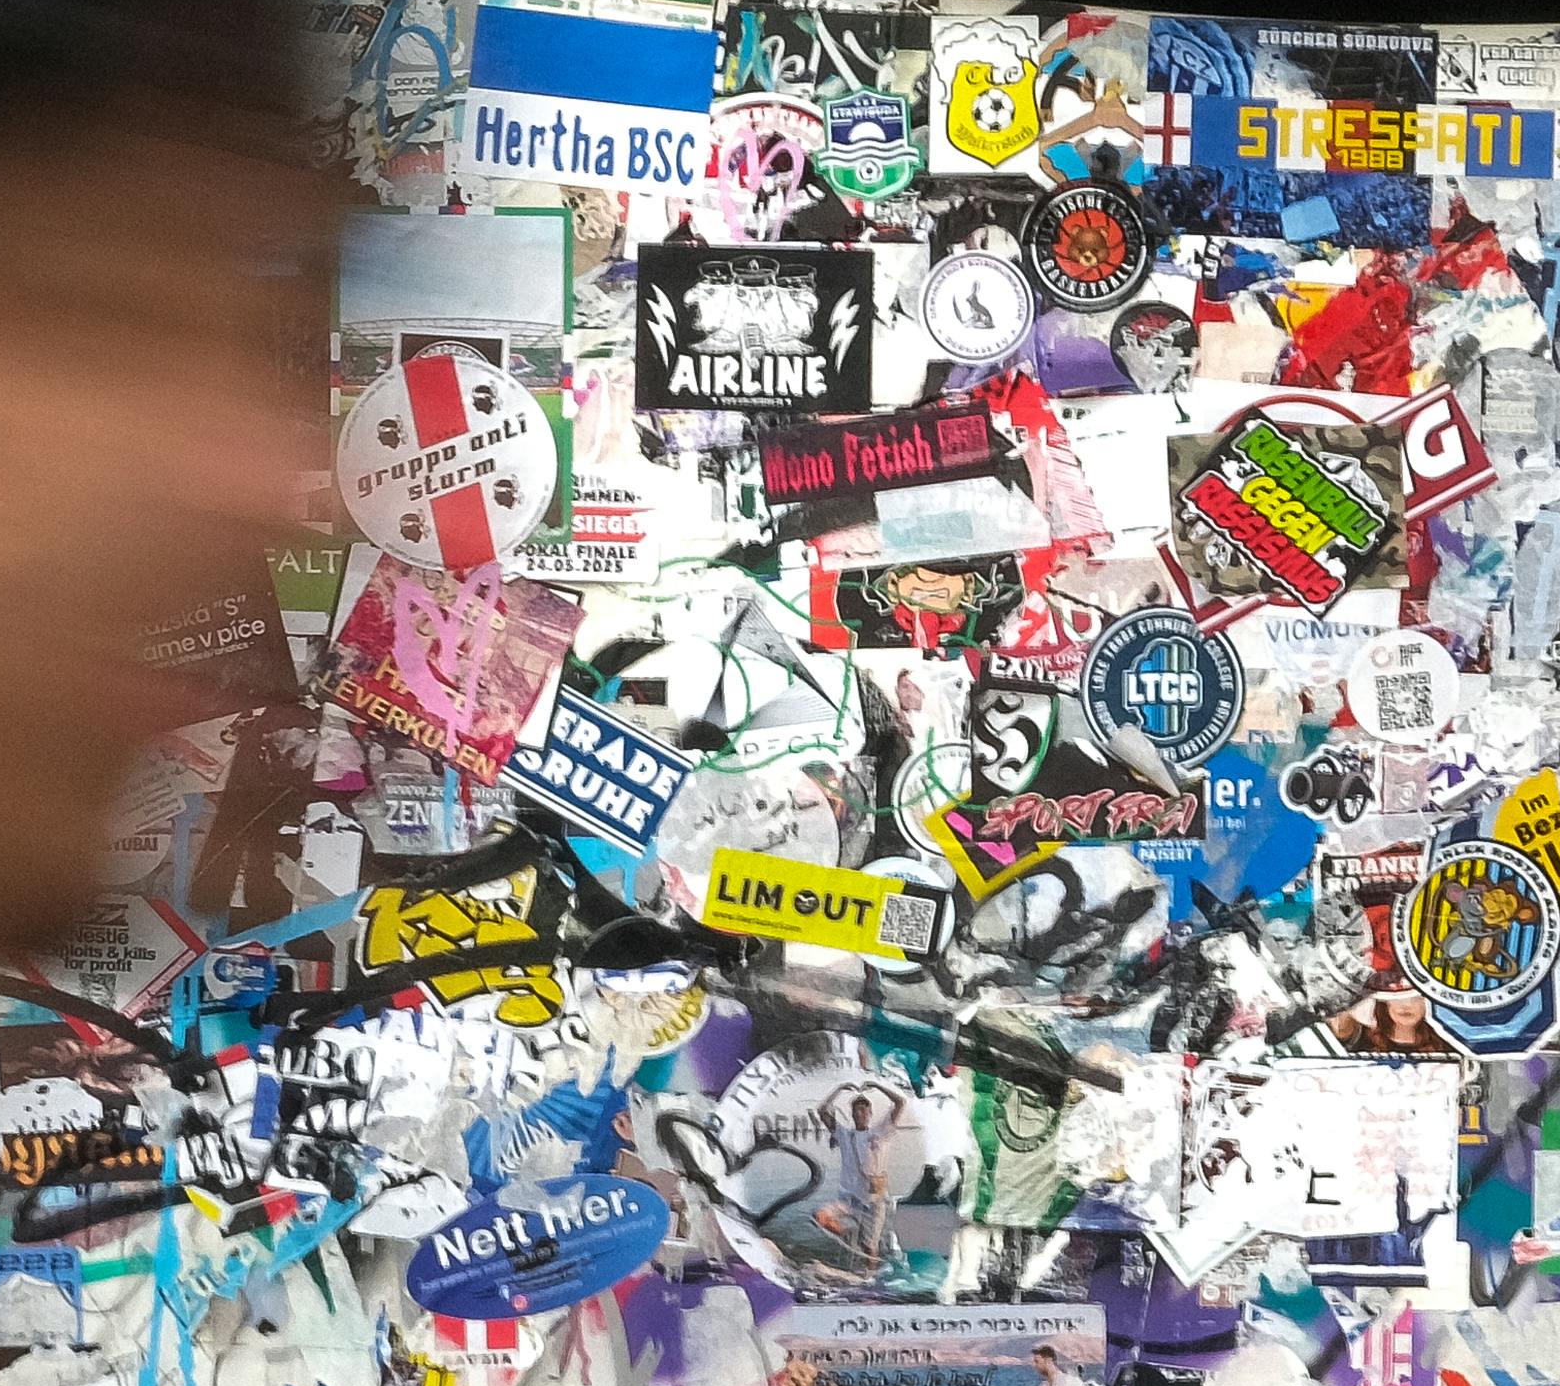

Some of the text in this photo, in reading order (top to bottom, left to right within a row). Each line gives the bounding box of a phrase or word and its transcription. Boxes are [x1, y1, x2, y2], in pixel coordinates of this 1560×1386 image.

[476, 105, 698, 188] Hertha BSC
[1238, 105, 1524, 158] STRESSATI
[1337, 146, 1405, 168] 1988
[668, 354, 829, 400] AIRLINE
[356, 414, 528, 500] gruppo anti
[842, 435, 934, 480] Fetish
[1239, 428, 1384, 549] RASENBALL
[1241, 475, 1335, 552] GEGEN
[575, 544, 637, 560] FINALE
[1188, 480, 1347, 606] RASSISMUS
[1127, 673, 1199, 705] LTCC
[716, 874, 784, 910] LIM
[435, 1214, 533, 1272] Nett
